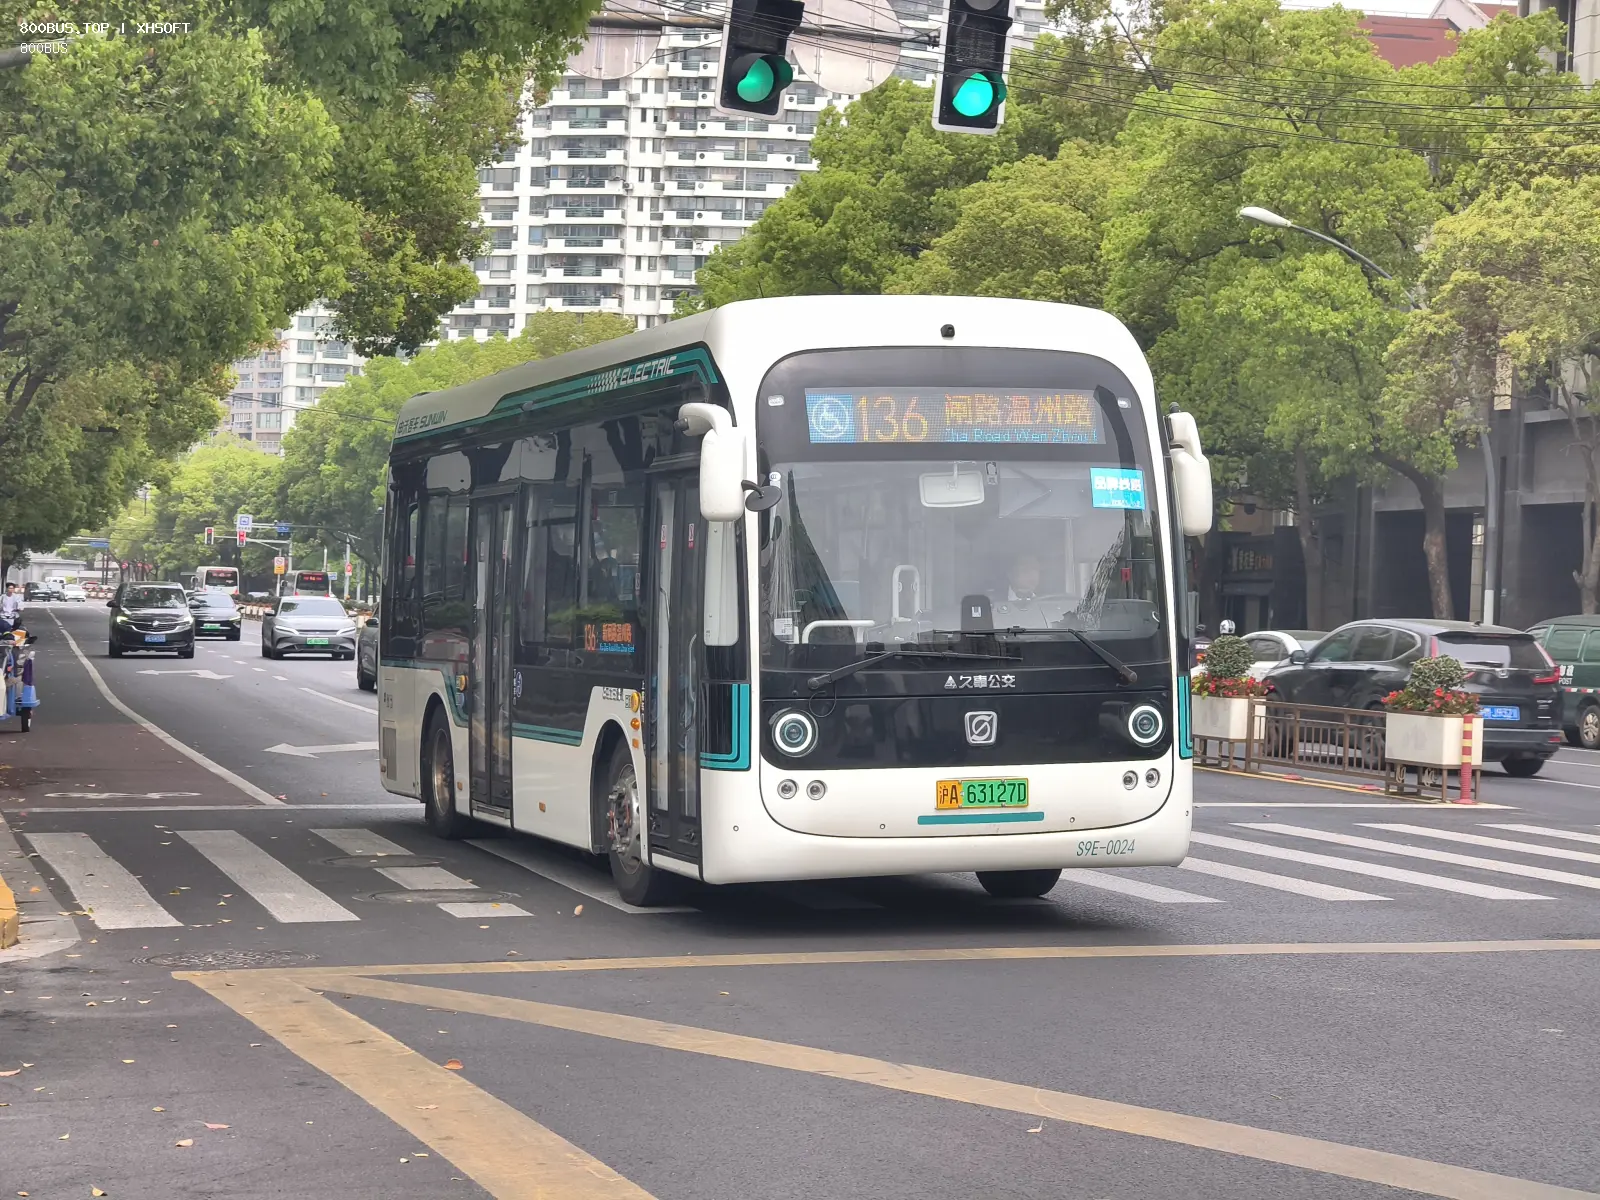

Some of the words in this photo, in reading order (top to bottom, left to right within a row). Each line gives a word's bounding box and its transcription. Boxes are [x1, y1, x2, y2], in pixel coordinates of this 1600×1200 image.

[619, 355, 678, 386] ELECTRIC
[420, 409, 448, 429] SUNWIN
[857, 395, 929, 442] 136
[974, 428, 1010, 442] Road
[584, 624, 596, 652] 136
[966, 782, 1027, 804] 63127D
[1076, 838, 1136, 857] S9E-0024
